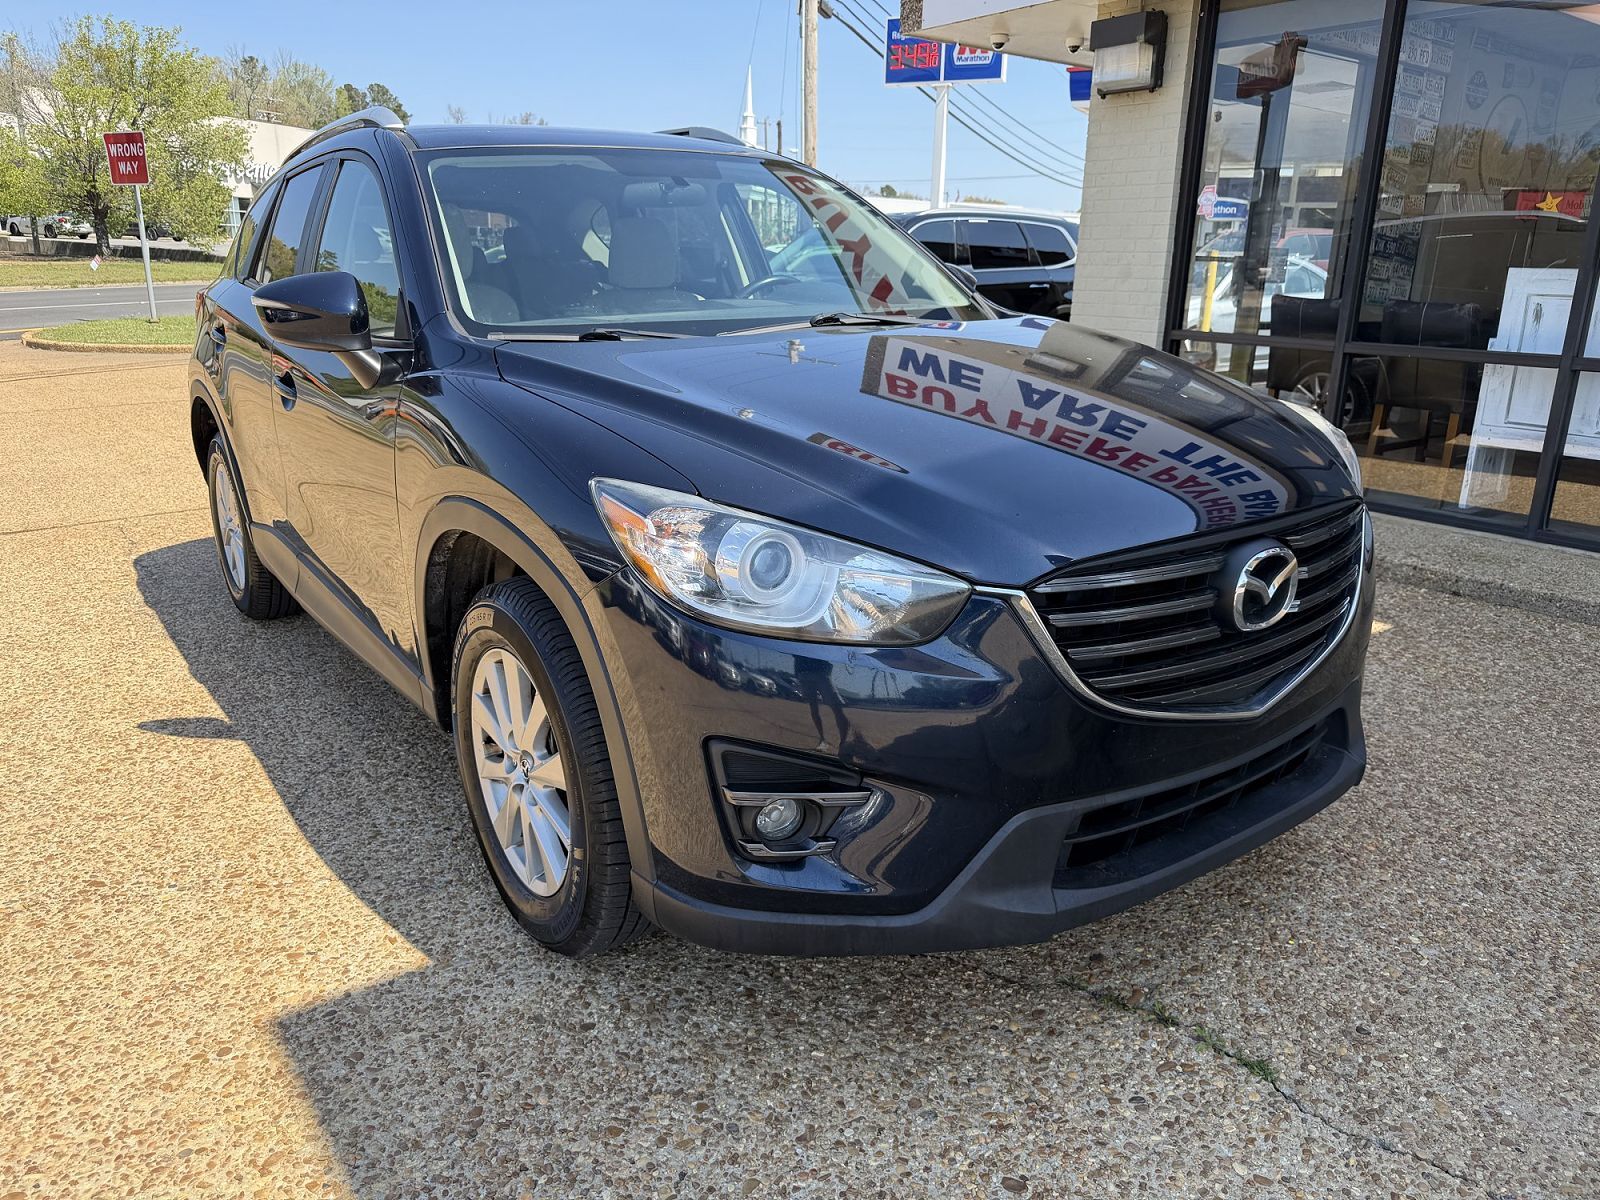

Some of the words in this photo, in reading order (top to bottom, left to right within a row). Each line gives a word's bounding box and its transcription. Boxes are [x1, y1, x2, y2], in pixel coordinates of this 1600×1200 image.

[956, 55, 990, 63] Marathon
[108, 142, 143, 157] WRONG
[118, 161, 139, 175] WAY
